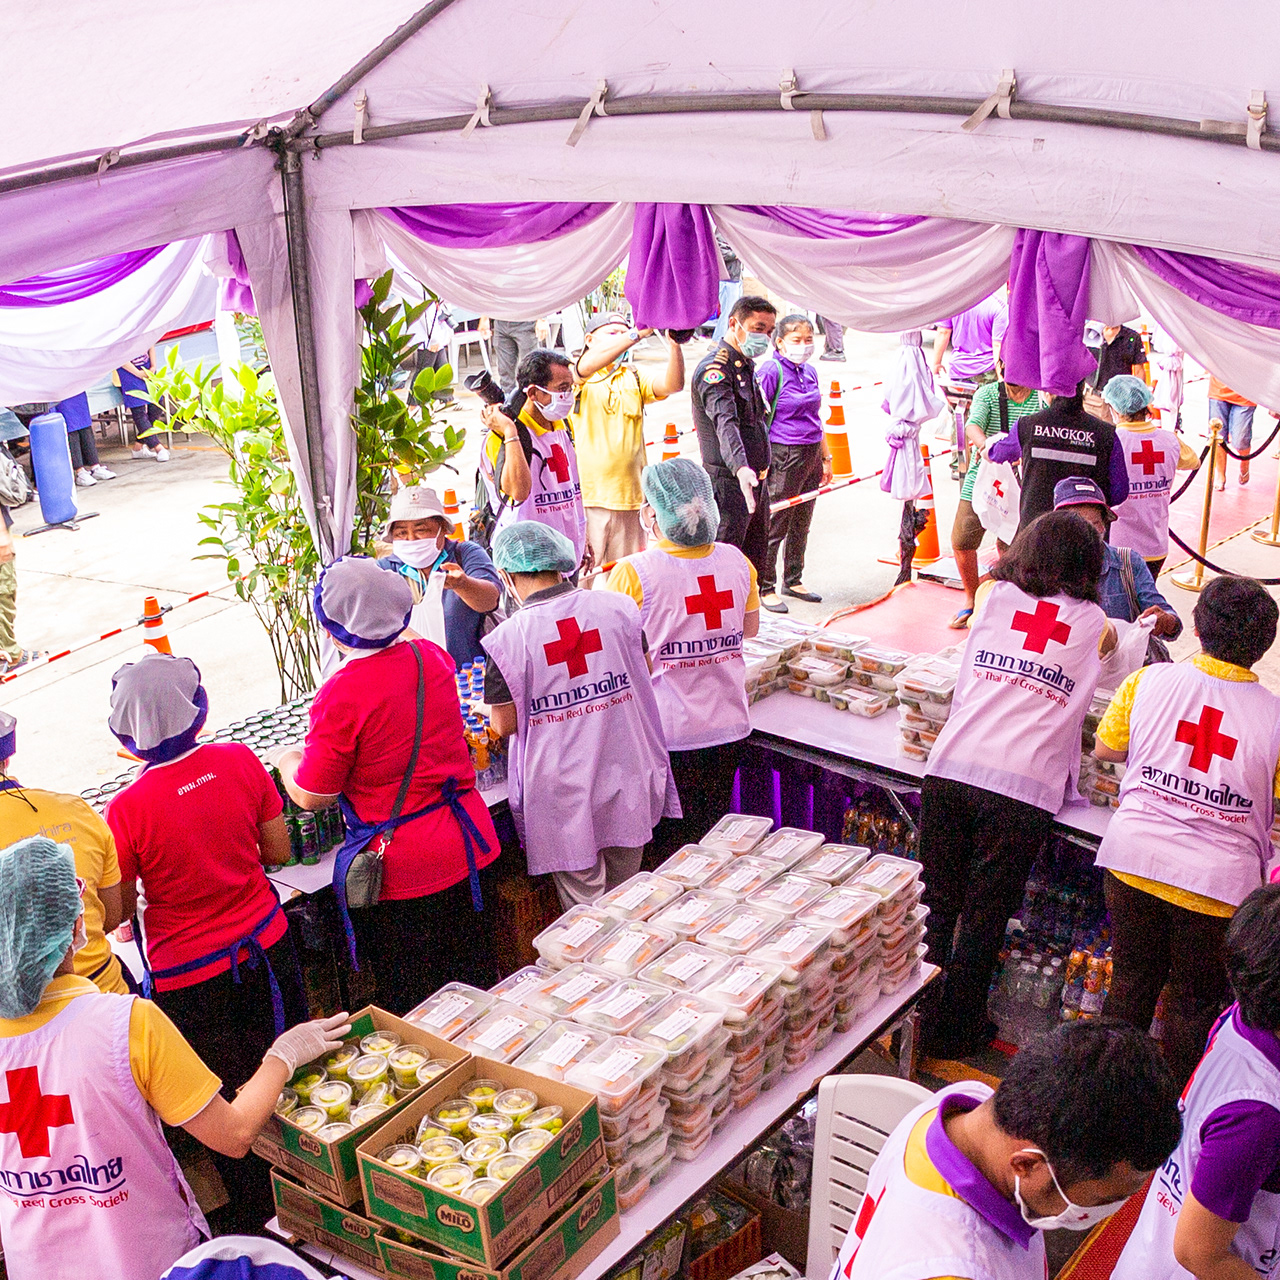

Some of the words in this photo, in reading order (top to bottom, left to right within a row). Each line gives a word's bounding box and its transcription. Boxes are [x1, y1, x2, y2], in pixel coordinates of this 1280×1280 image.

[1033, 425, 1095, 443] BANGKOK
[662, 662, 676, 670] The
[679, 661, 696, 669] Thai
[698, 658, 712, 668] Red
[974, 649, 1076, 693] สภากาชาดไทย
[985, 671, 1003, 683] Thai
[1019, 678, 1043, 695] Cross
[546, 713, 565, 724] Thai
[566, 707, 583, 720] Red
[585, 701, 610, 715] Cross
[176, 770, 218, 797] อพม.กทม.
[1141, 765, 1253, 809] สภากาชาดไทย
[1189, 802, 1216, 818] Cross
[300, 1137, 320, 1156] MILO
[21, 1197, 46, 1209] Red
[49, 1195, 87, 1209] Cross
[90, 1189, 130, 1209] Society
[342, 1219, 370, 1237] MILO
[440, 1209, 472, 1229] MILO
